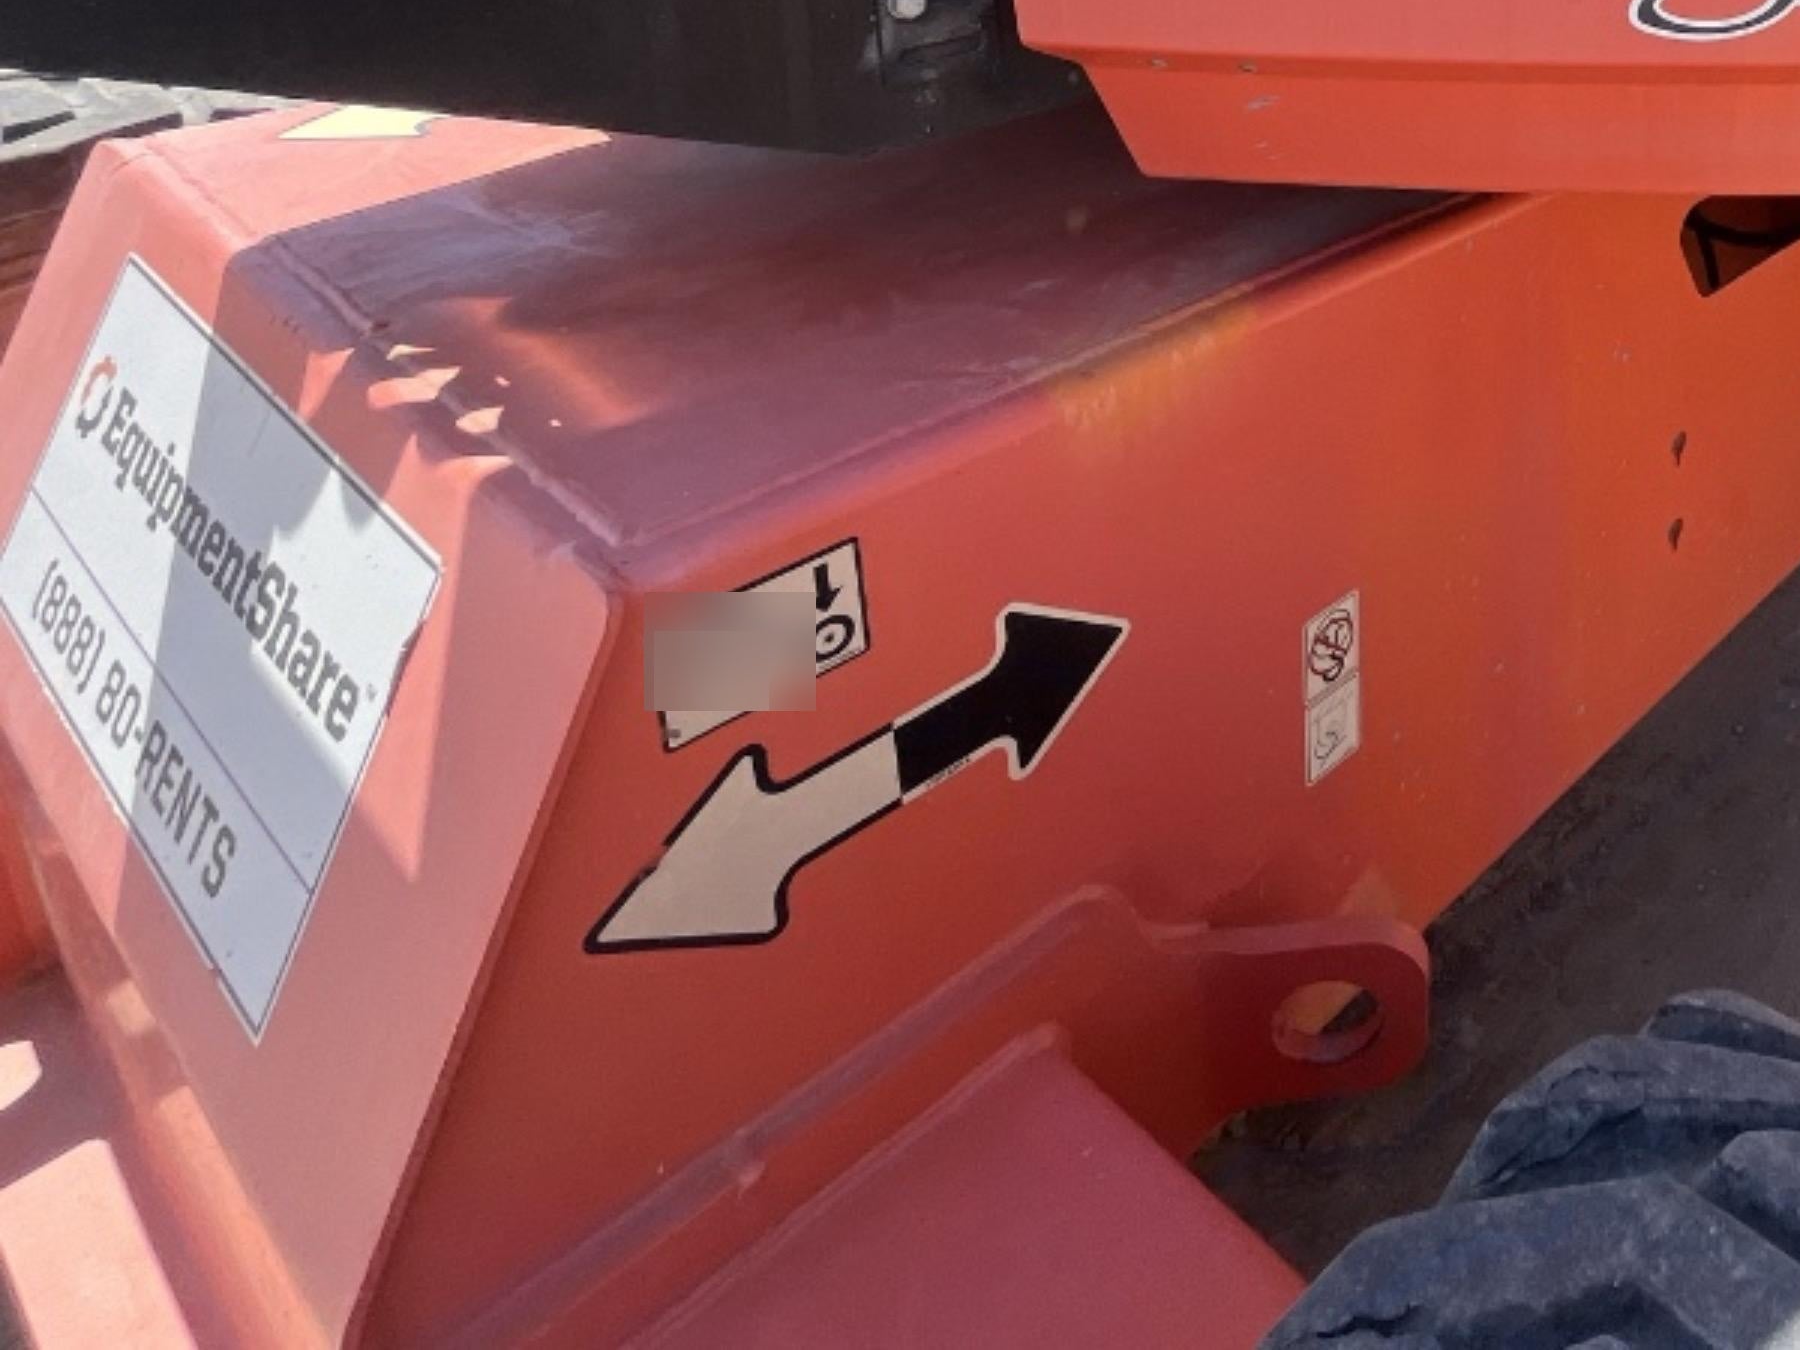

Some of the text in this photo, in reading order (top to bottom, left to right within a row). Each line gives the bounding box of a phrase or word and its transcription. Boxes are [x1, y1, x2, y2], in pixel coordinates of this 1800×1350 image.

[31, 557, 237, 902] (888) 80-RENTS
[99, 385, 366, 745] EquipmentShare
